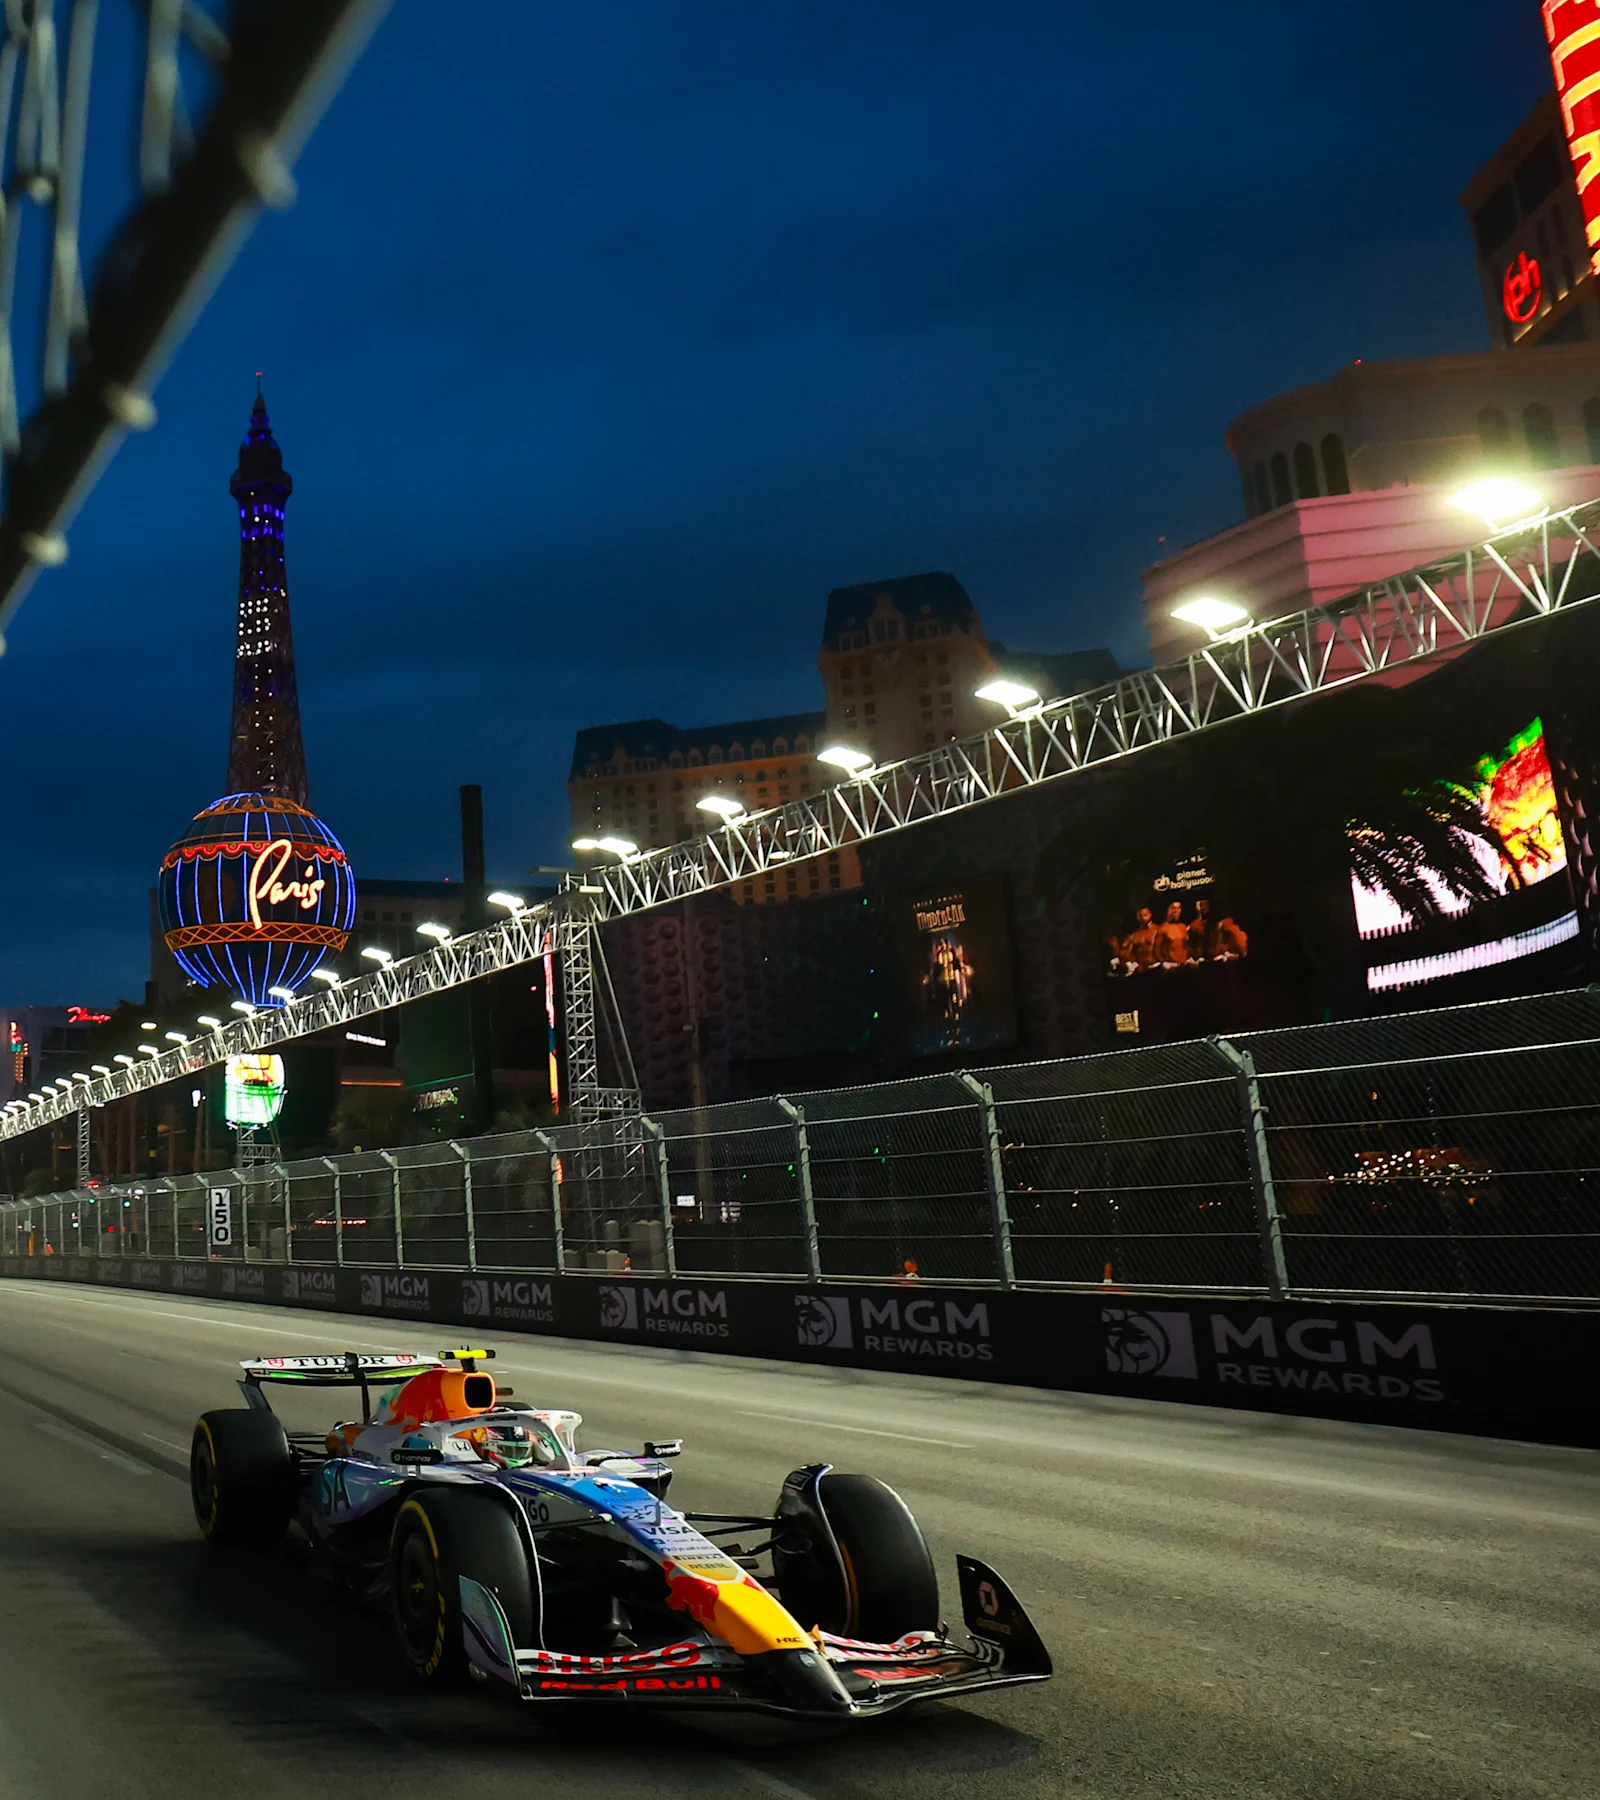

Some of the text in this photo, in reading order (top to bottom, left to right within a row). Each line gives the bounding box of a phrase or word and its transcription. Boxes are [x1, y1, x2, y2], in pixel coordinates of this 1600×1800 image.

[249, 838, 326, 930] Paris
[214, 1191, 229, 1242] 150
[300, 1272, 336, 1291] MGM
[384, 1275, 430, 1298] MGM
[492, 1280, 553, 1306] MGM
[494, 1305, 554, 1323] REWARDS
[642, 1287, 728, 1319] MGM
[645, 1317, 730, 1338] REWARDS
[860, 1297, 990, 1337] MGM
[864, 1335, 994, 1361] REWARDS
[1210, 1313, 1438, 1370] MGM
[1216, 1361, 1445, 1401] REWARDS
[639, 1526, 697, 1535] VISA
[540, 1675, 722, 1690] Red Bull
